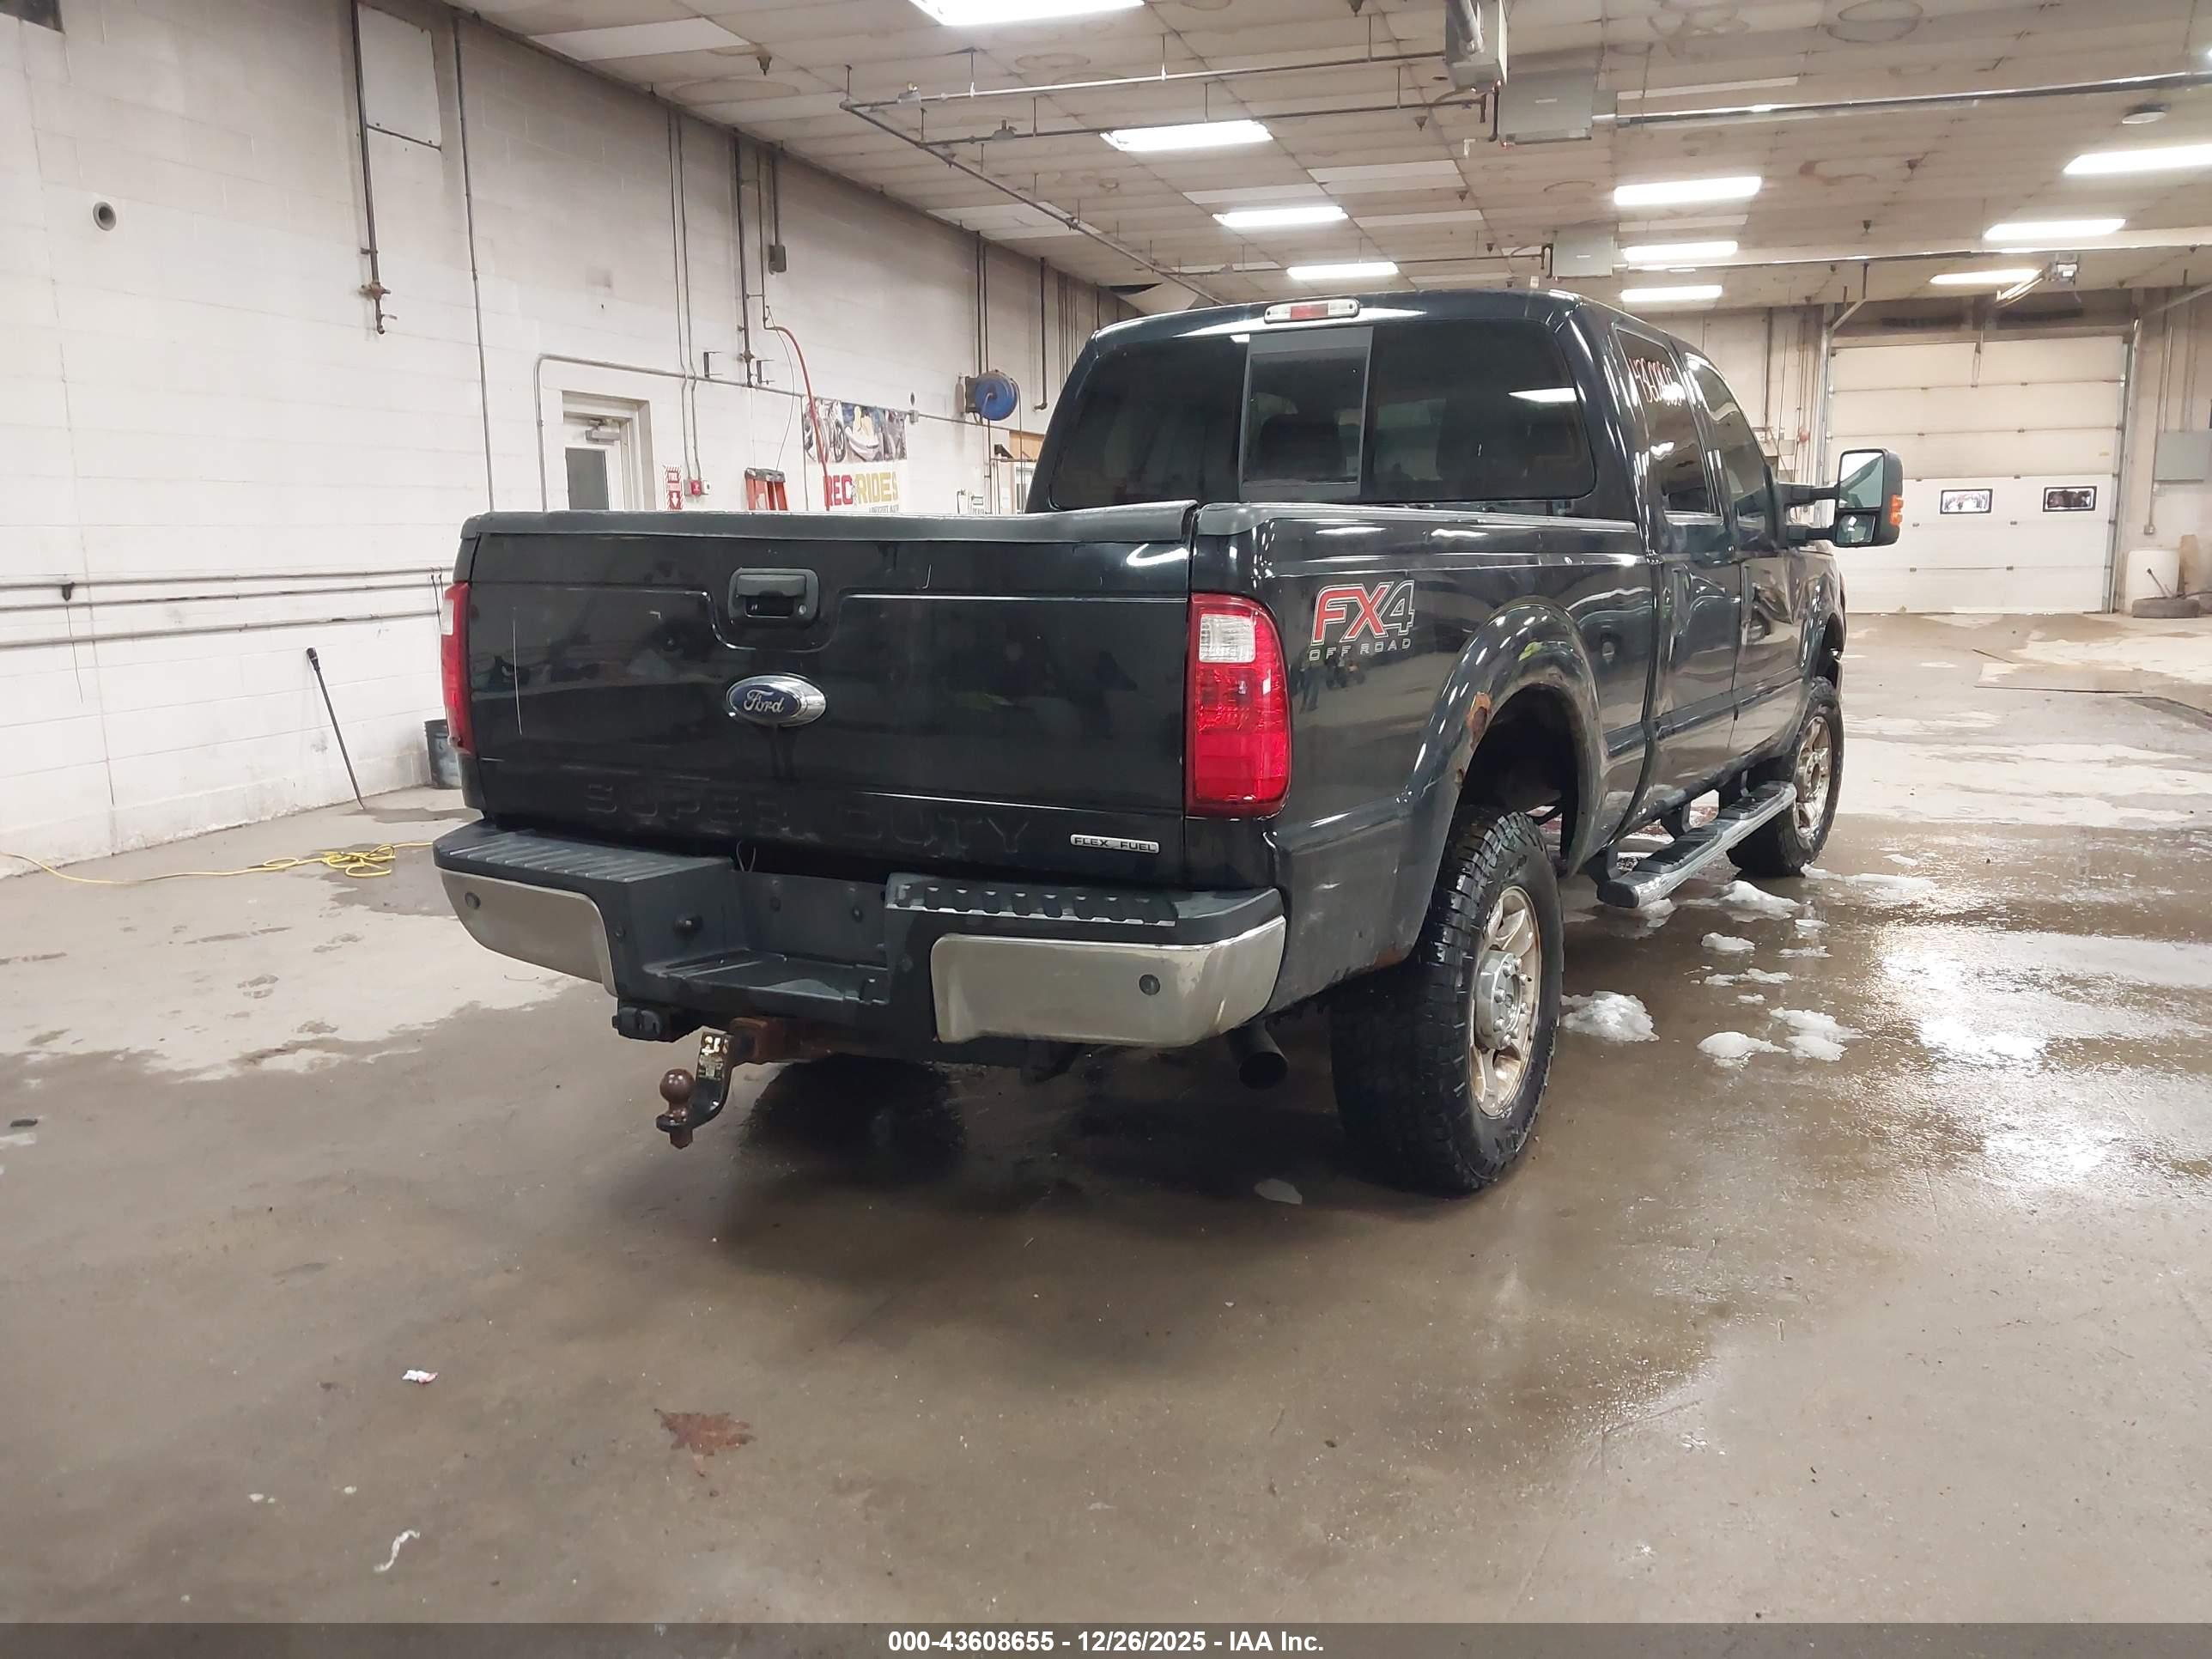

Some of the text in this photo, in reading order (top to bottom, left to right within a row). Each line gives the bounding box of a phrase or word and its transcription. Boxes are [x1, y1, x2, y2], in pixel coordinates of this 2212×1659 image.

[823, 474, 854, 507] REC
[855, 471, 899, 504] RIDES
[1310, 580, 1415, 647] FX4
[1309, 638, 1412, 662] OFF ROAD
[743, 689, 785, 713] Ford
[583, 781, 1030, 857] SUPER DUTY
[1073, 836, 1157, 853] FLEX FUEL
